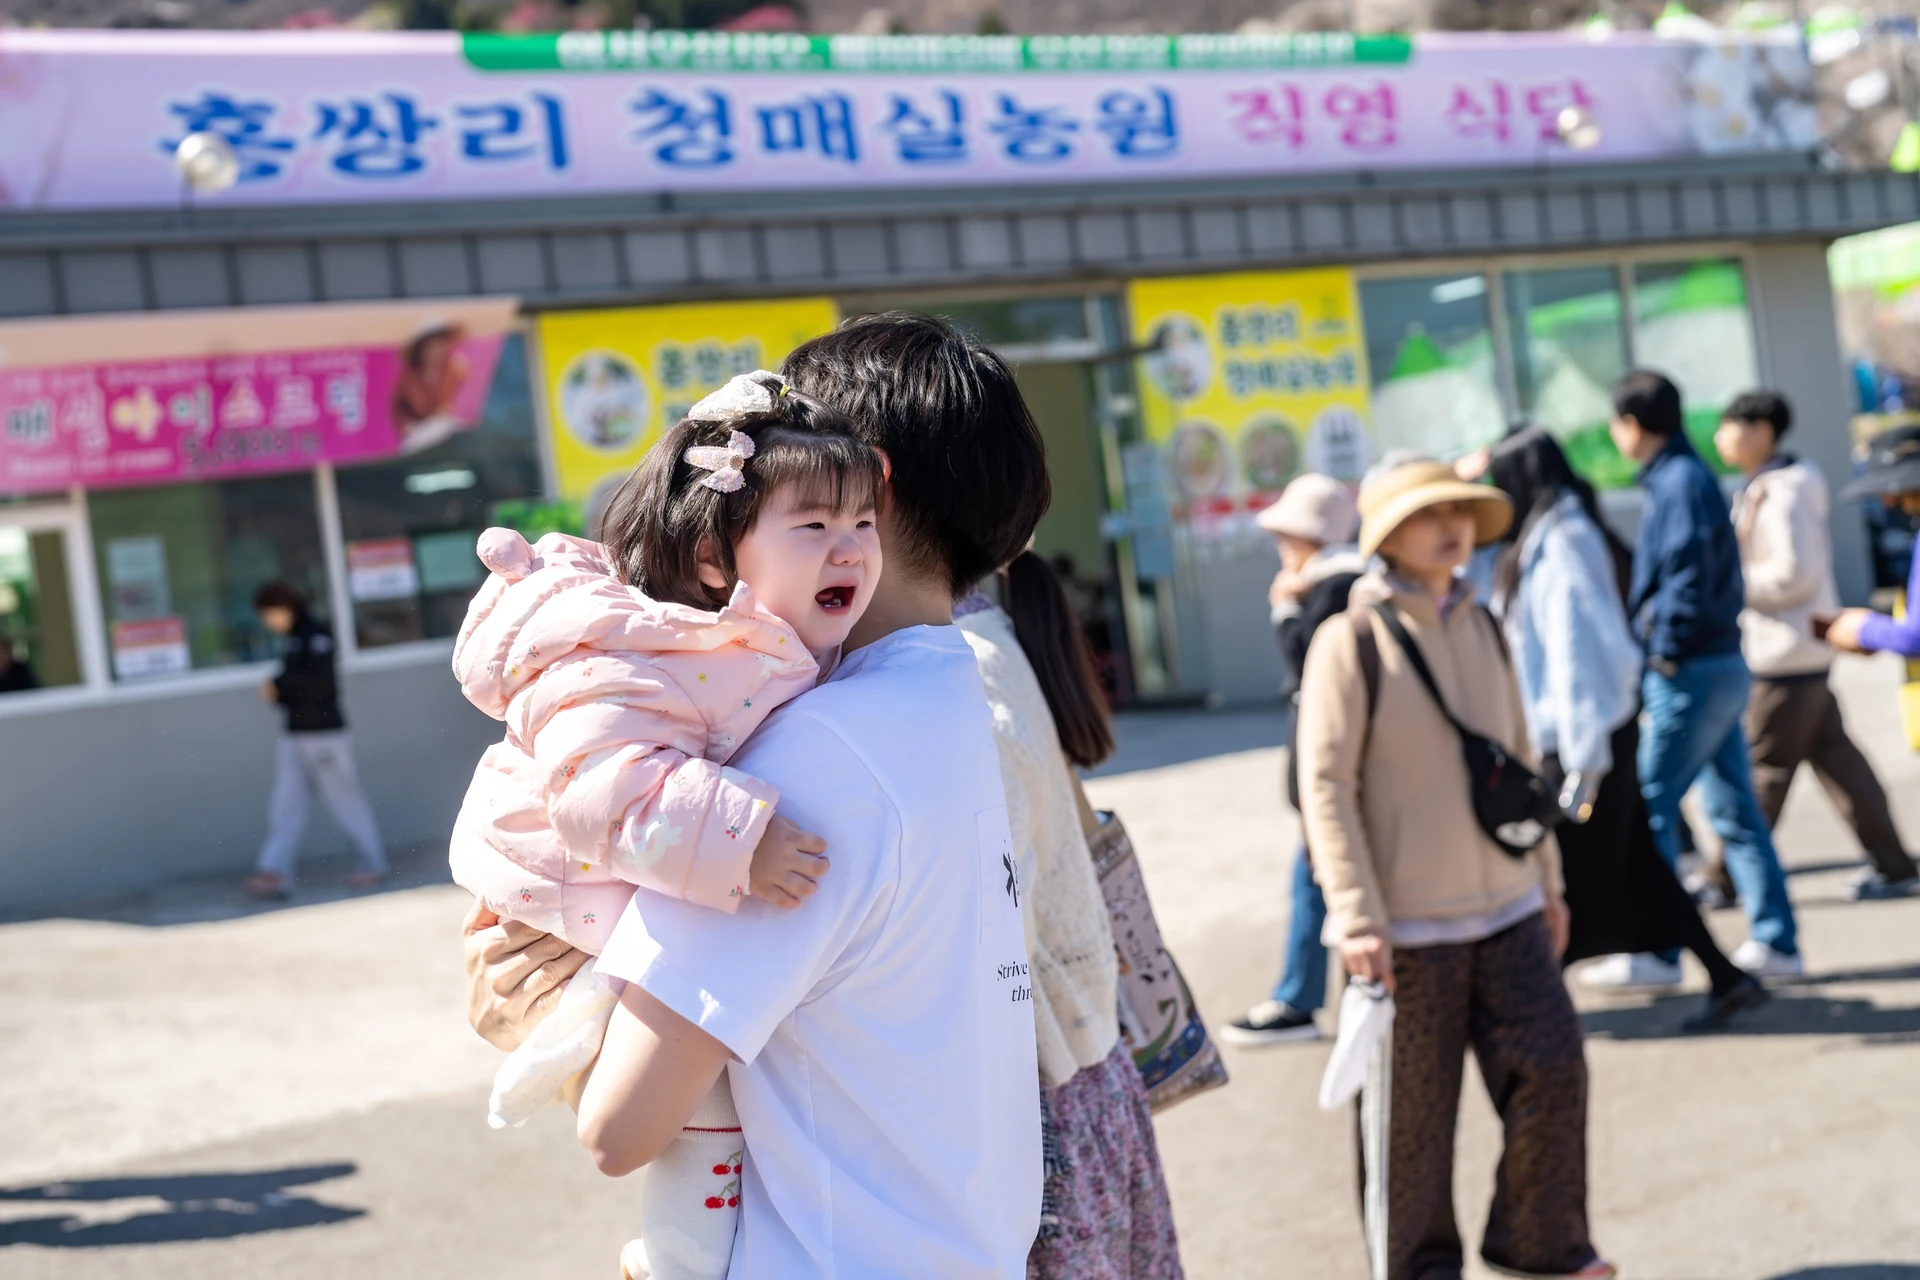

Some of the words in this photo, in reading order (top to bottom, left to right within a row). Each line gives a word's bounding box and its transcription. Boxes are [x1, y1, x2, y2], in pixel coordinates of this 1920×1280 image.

[158, 91, 570, 183] 홍쌍리
[630, 86, 1181, 166] 청매실농원
[1227, 81, 1401, 150] 직영
[997, 961, 1028, 981] Strive
